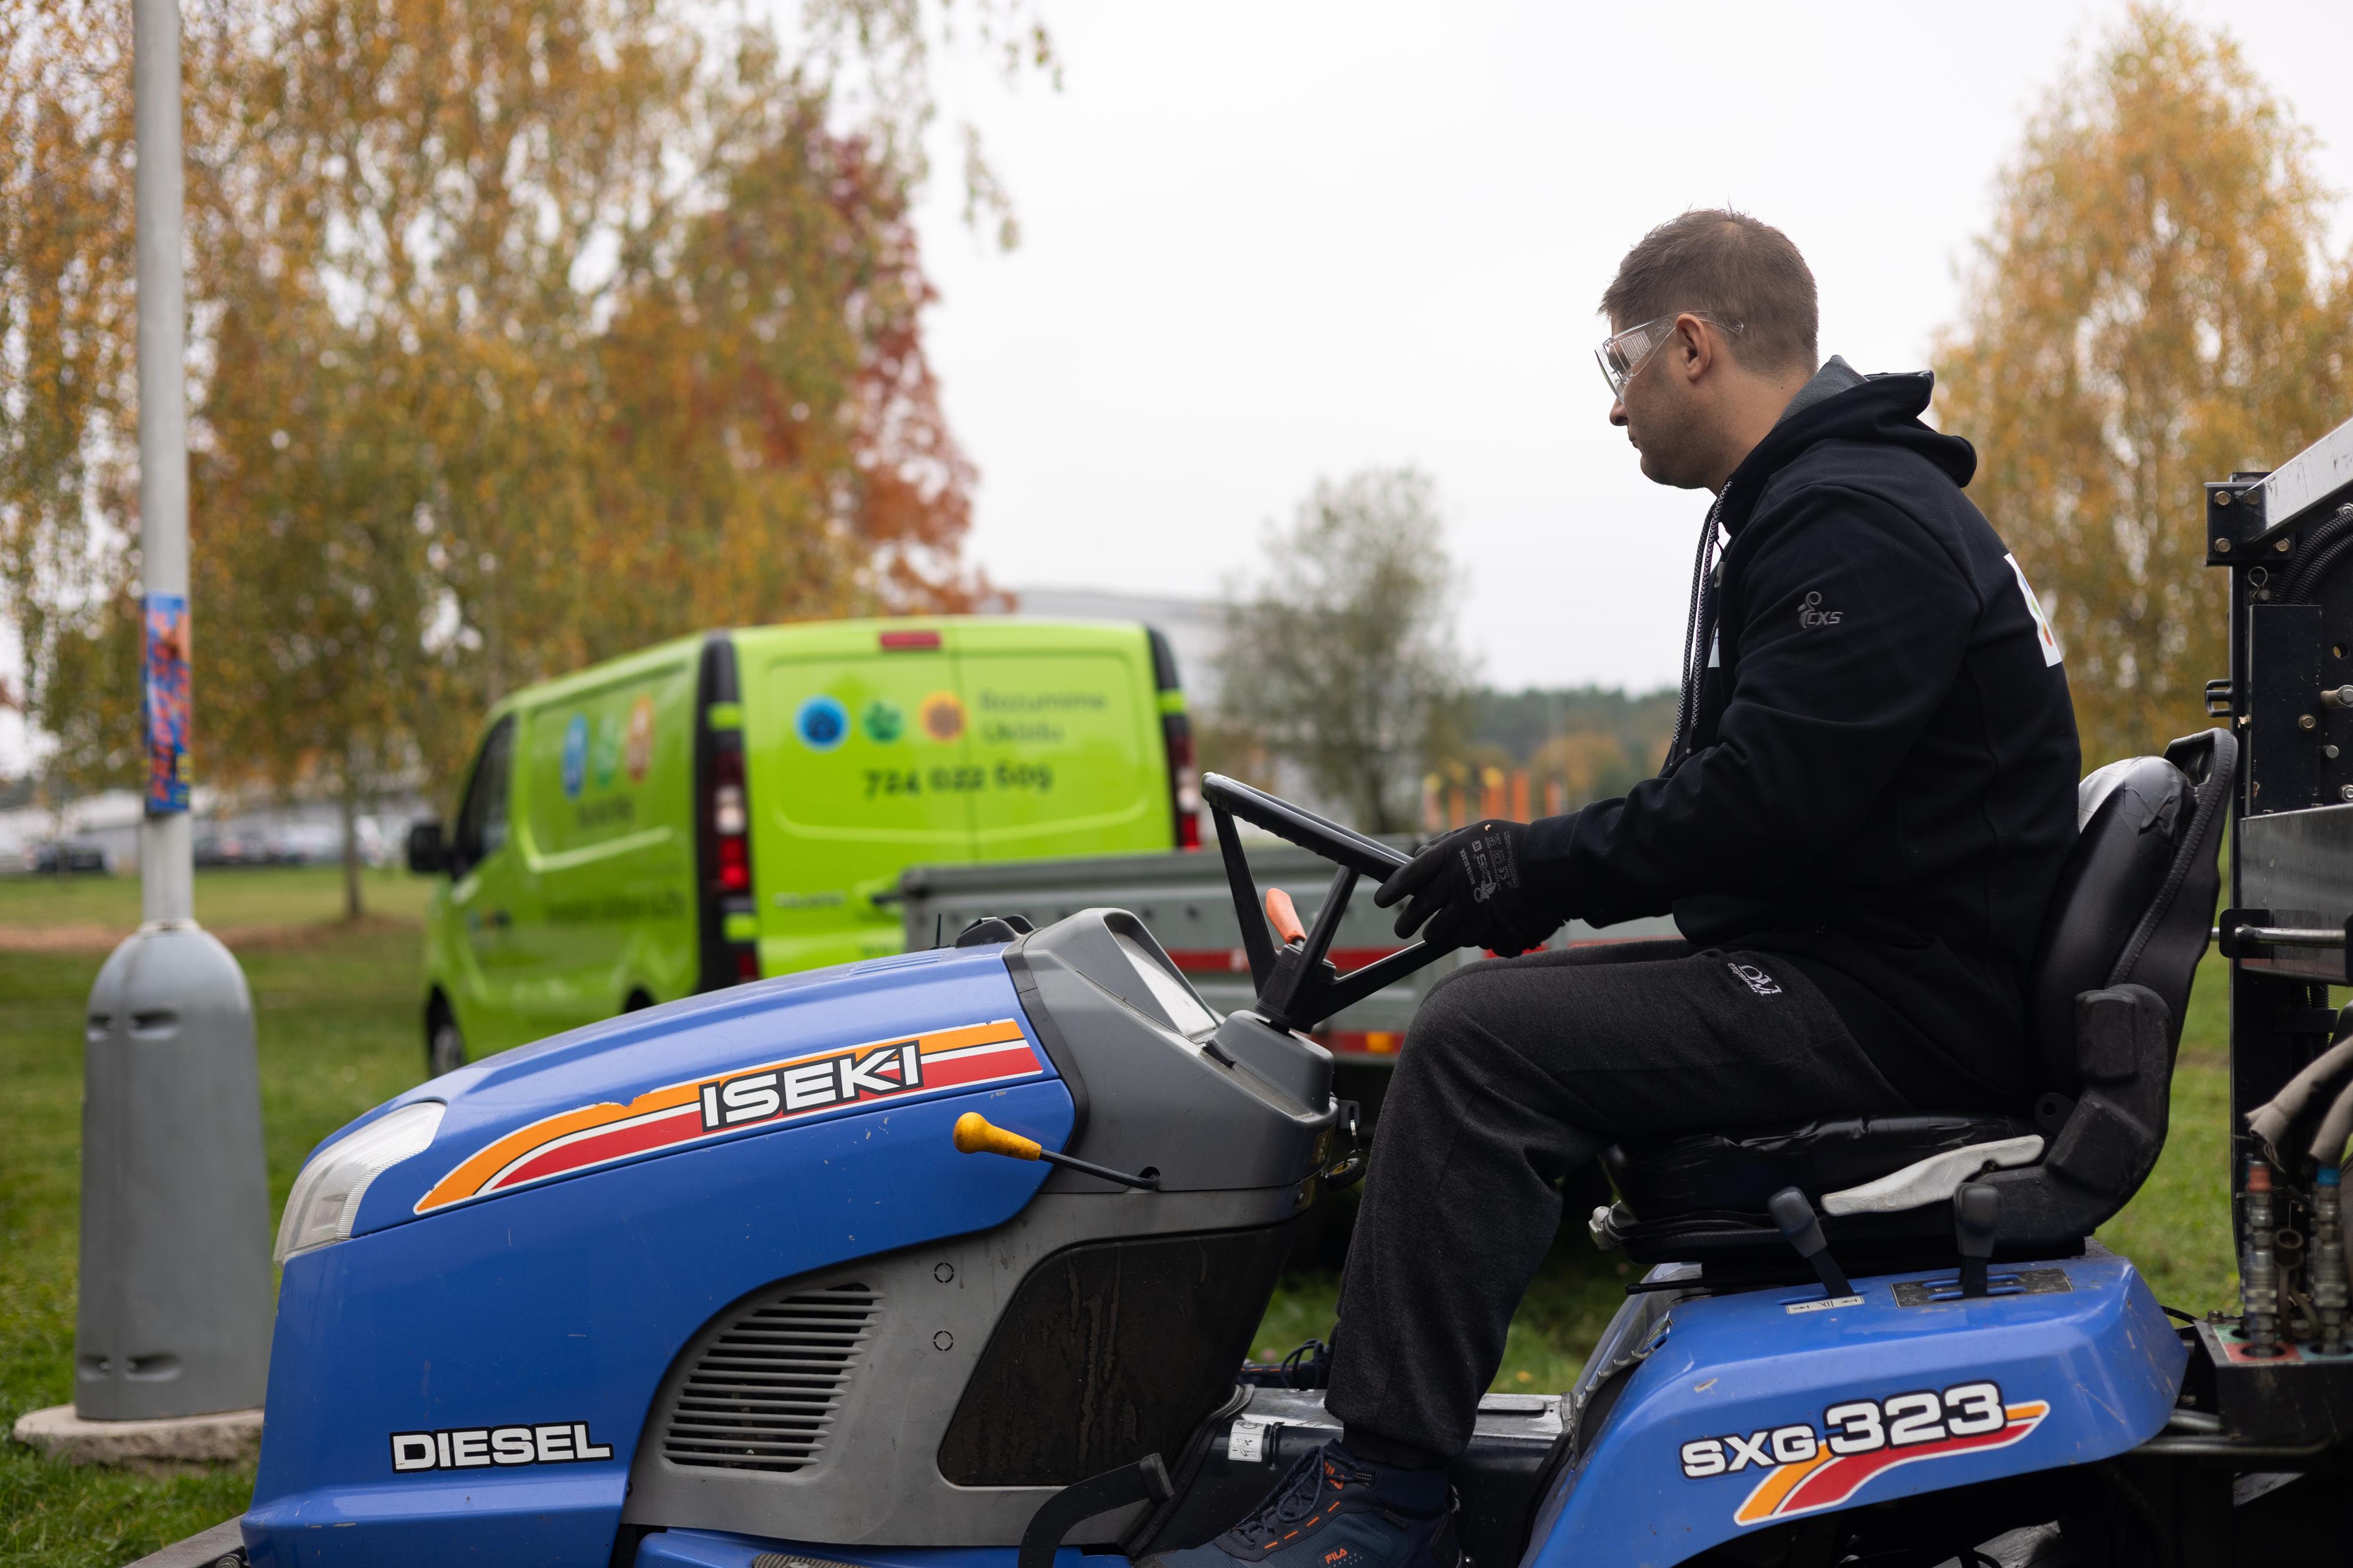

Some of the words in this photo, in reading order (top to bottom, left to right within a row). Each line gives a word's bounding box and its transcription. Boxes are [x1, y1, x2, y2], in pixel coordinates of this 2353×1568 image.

[1807, 611, 1844, 626] CXS
[705, 1044, 919, 1128] ISEKI
[392, 1424, 611, 1470] DIESEL
[1681, 1426, 1818, 1479] SXG
[1826, 1383, 2005, 1455] 323
[1325, 1548, 1347, 1564] FILA
